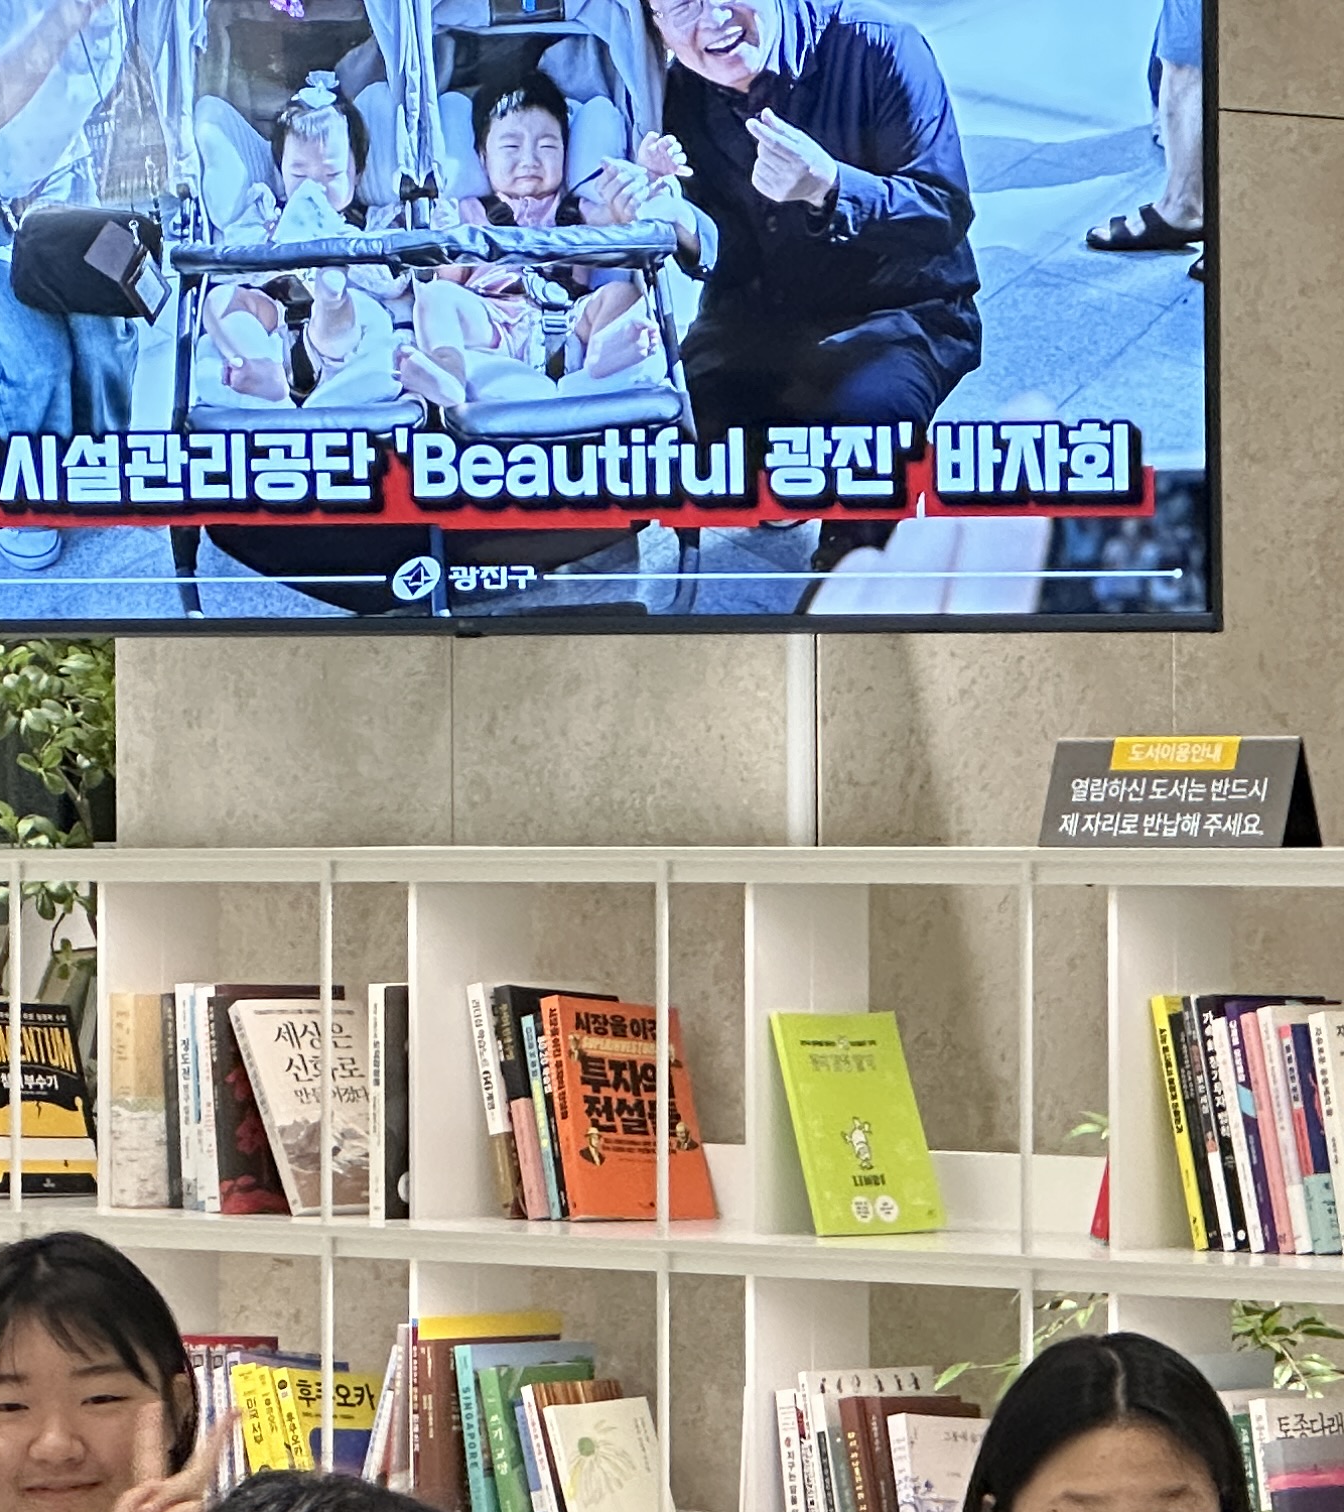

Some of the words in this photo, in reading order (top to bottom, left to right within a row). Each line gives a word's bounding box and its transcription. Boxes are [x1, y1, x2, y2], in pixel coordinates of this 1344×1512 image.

[391, 425, 745, 500] 'Beautiful
[766, 425, 914, 500] 광진'
[935, 420, 1133, 498] 바자회
[447, 562, 539, 592] 광진구
[1129, 742, 1222, 762] 도서이용안내
[1071, 778, 1147, 802] 열람하신
[1149, 779, 1206, 801] 도서는
[1210, 778, 1268, 802] 반드시
[1059, 813, 1078, 836] 제
[1083, 812, 1139, 837] 자리로
[1143, 813, 1200, 837] 반납해
[1203, 814, 1264, 836] 주세요.
[471, 999, 485, 1028] 리더십
[549, 1008, 560, 1036] 시장을
[575, 1012, 627, 1035] 시장을
[552, 1037, 562, 1058] 이긴
[554, 1060, 565, 1090] 투자의
[296, 1372, 375, 1411] 후오카
[461, 1387, 479, 1470] SINGAPORE
[1278, 1412, 1344, 1438] 토종다래
